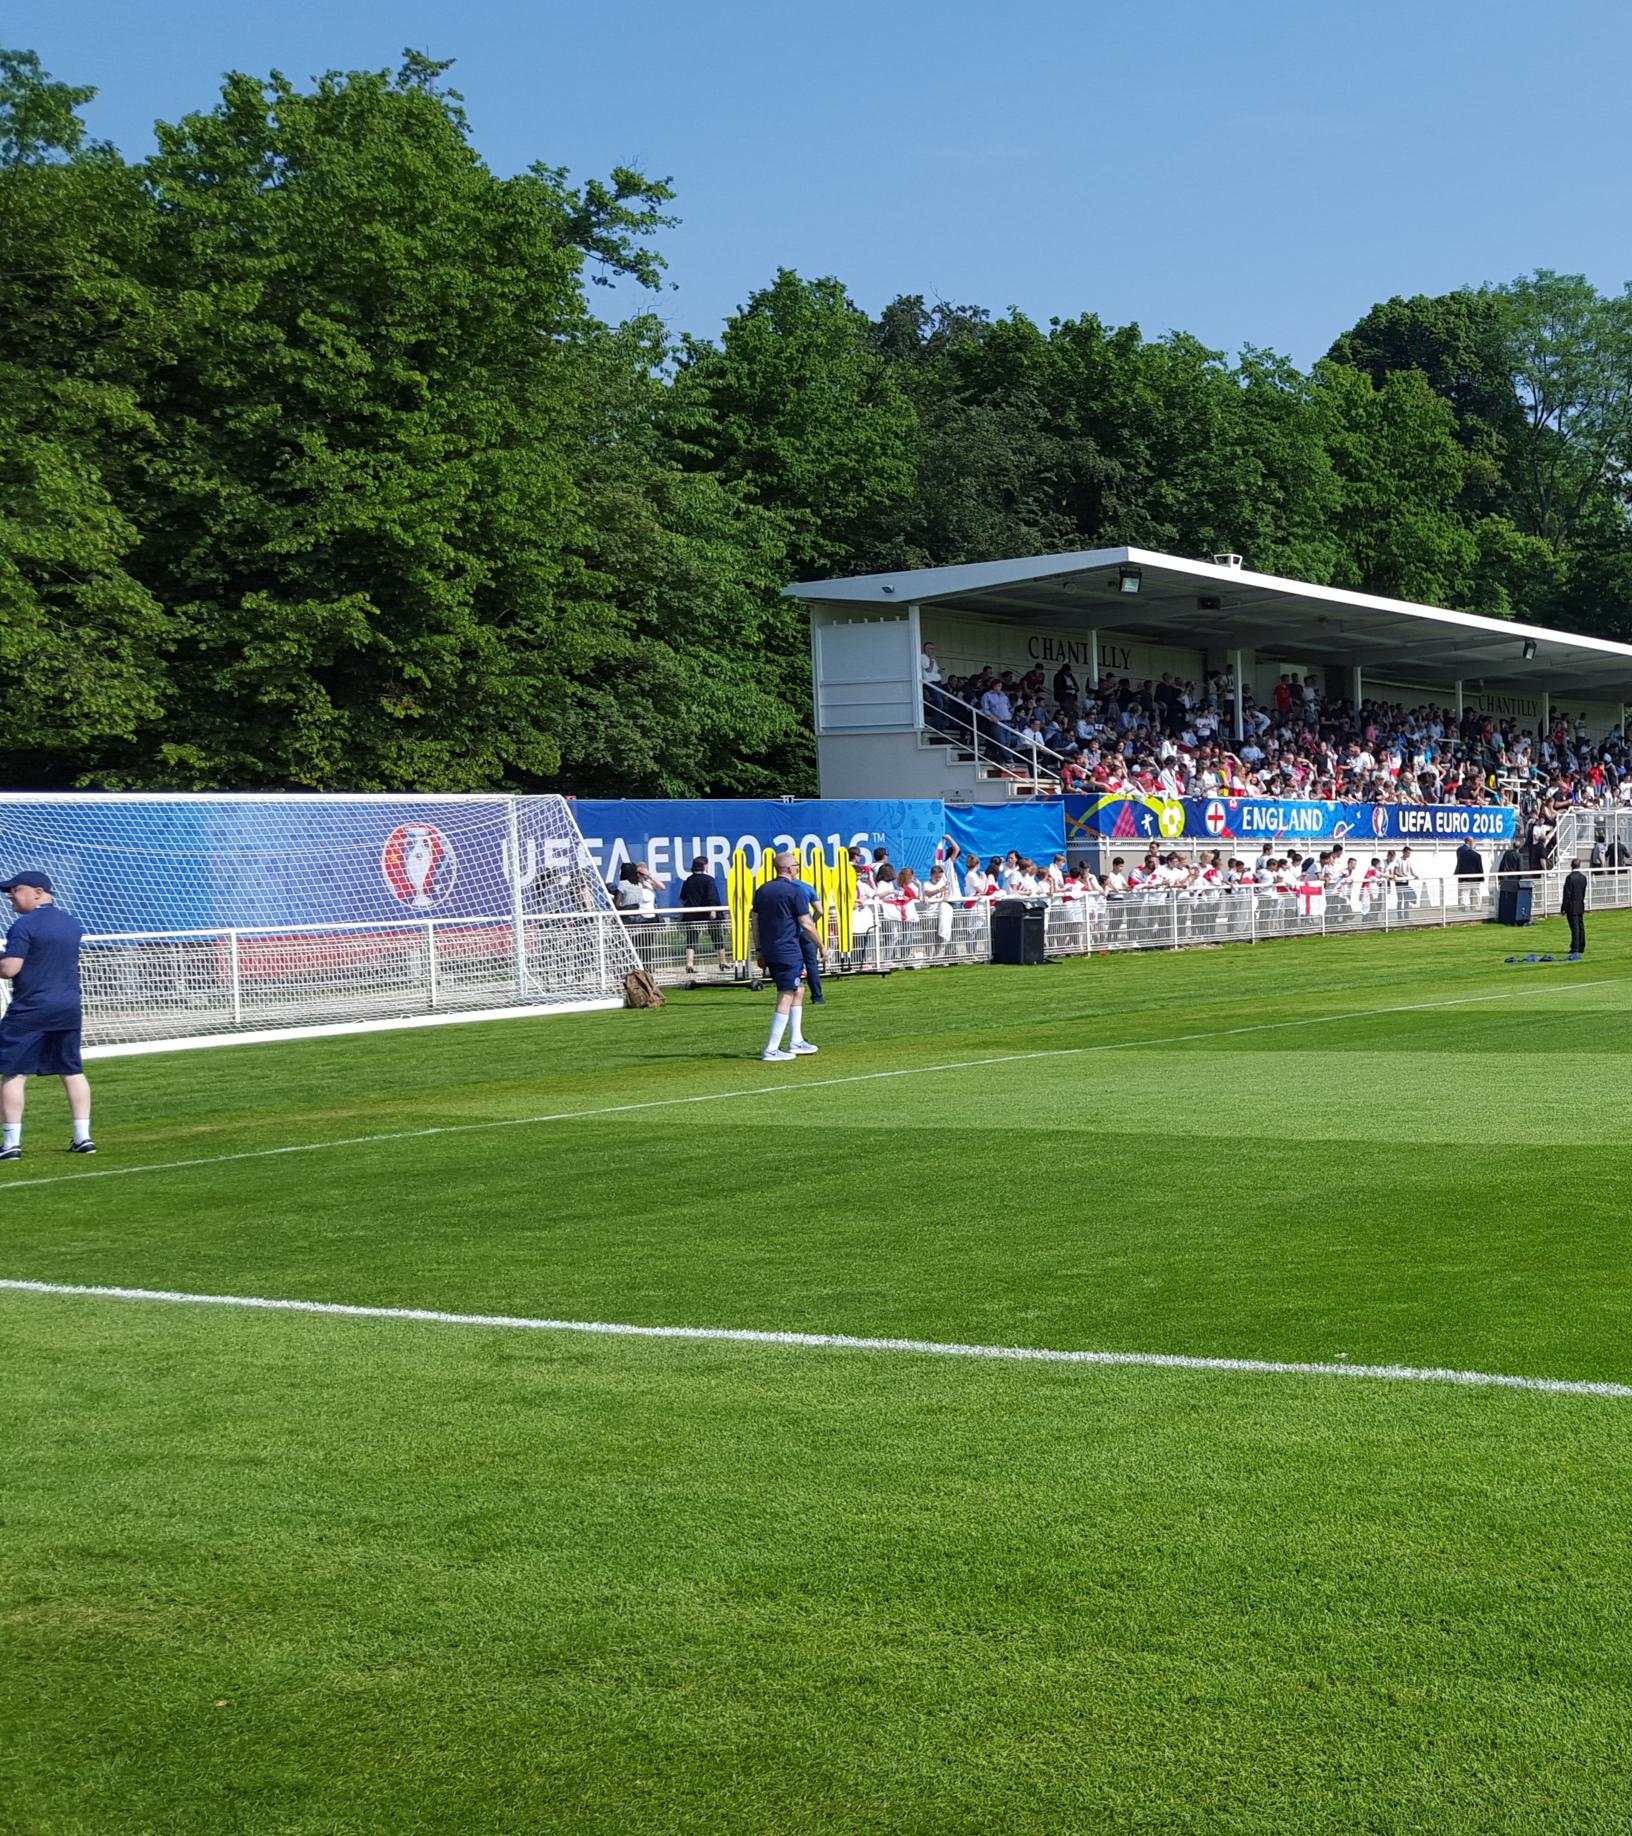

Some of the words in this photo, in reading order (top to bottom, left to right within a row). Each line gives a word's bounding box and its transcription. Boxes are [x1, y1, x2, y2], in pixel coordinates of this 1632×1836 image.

[1028, 636, 1130, 669] CHANTLLY
[1479, 694, 1537, 717] CHANTILLY
[1242, 806, 1323, 830] ENGLAND
[1399, 811, 1432, 832] UEFA
[1436, 811, 1469, 833] EURO
[1473, 812, 1503, 833] 2016
[648, 834, 761, 882] EURO
